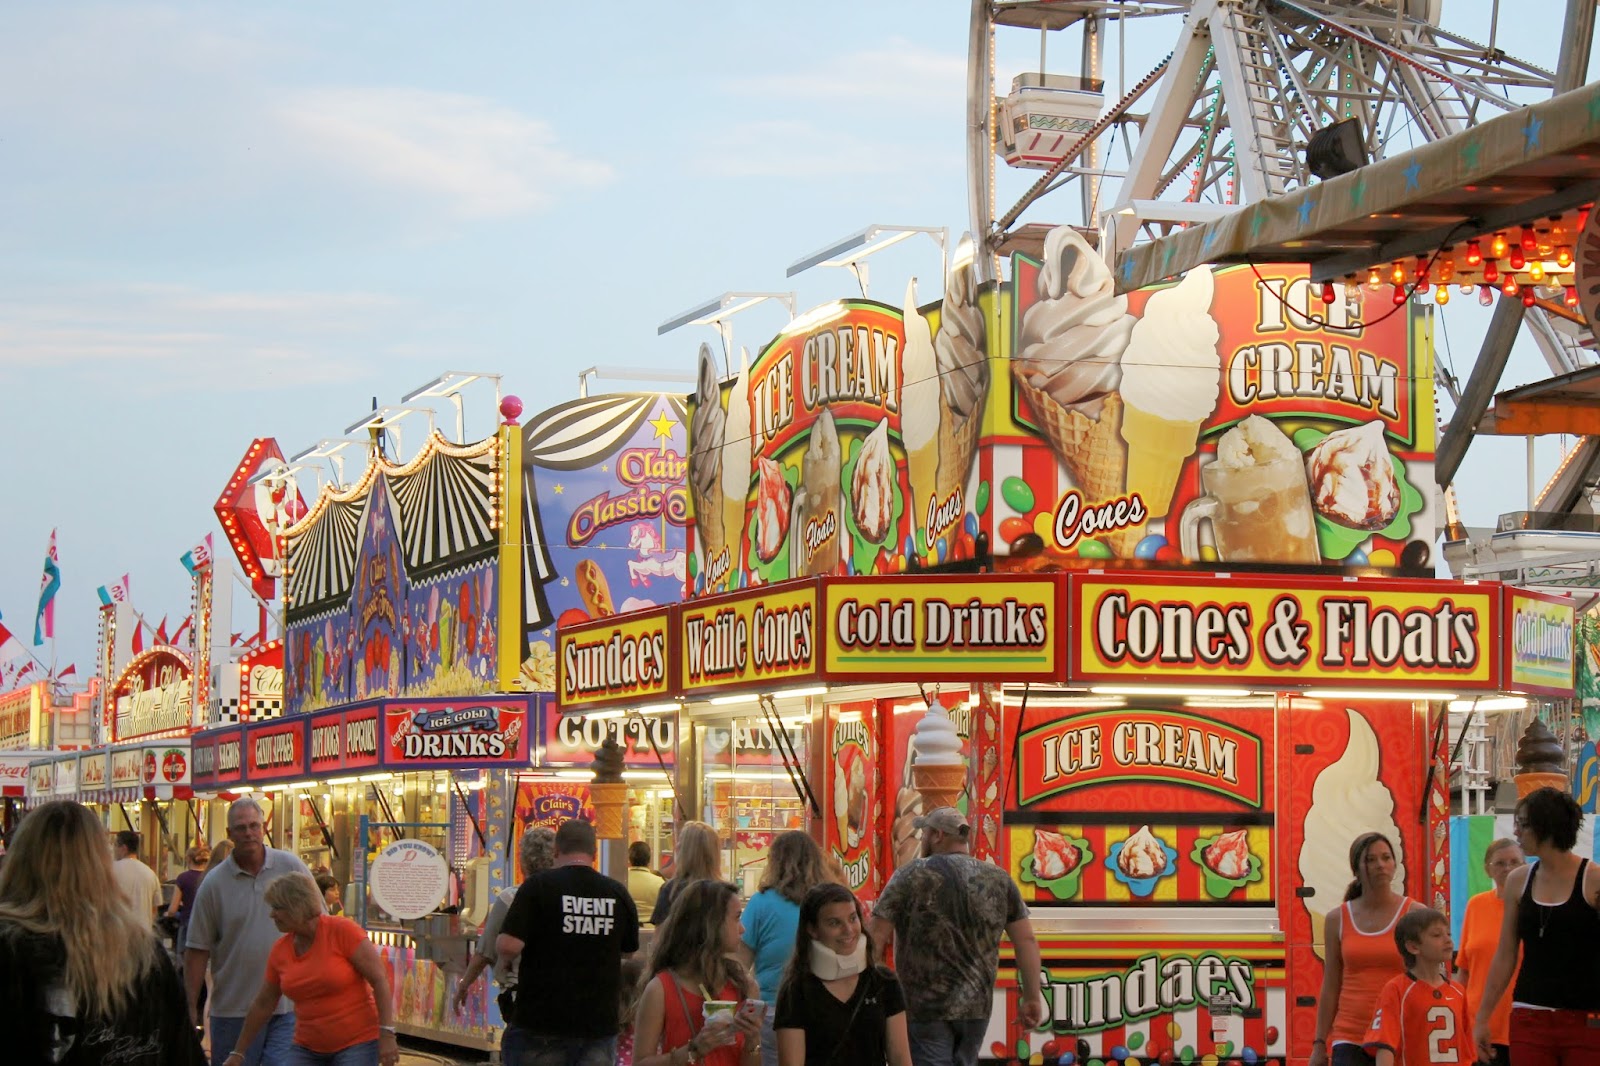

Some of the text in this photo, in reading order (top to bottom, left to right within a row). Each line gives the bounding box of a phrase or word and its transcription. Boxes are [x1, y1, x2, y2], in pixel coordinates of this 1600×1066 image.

[1257, 279, 1362, 336] ICE
[753, 326, 898, 456] ICE CREAM
[1230, 342, 1399, 420] CREAM
[619, 451, 687, 482] Clair
[570, 489, 662, 541] Classic
[806, 512, 836, 552] Floats
[926, 490, 962, 548] Cones
[1055, 494, 1145, 547] Cones
[1502, 516, 1515, 531] 15
[706, 547, 730, 595] Cones
[687, 604, 812, 676] Waffle Cones
[839, 601, 1046, 645] Cold Drinks
[1098, 594, 1475, 664] Cones & Floats
[1516, 611, 1572, 662] Cold Drinks
[565, 633, 664, 693] Sundaes
[346, 718, 377, 754] POPCORN
[430, 709, 488, 728] ICE GOLD
[558, 716, 675, 748] COTTO
[707, 727, 804, 750] CAND
[832, 718, 870, 757] Cones
[256, 732, 294, 766] CANDY APPLES
[312, 725, 340, 758] HOT DOGS
[405, 733, 506, 757] DRINKS
[1043, 721, 1237, 783] ICE CREAM
[540, 798, 573, 813] Clair's
[386, 846, 398, 857] DID
[413, 843, 436, 858] KNOW?
[832, 848, 869, 888] oats
[562, 895, 617, 916] EVENT
[562, 917, 615, 936] STAFF
[1426, 1006, 1460, 1064] 2
